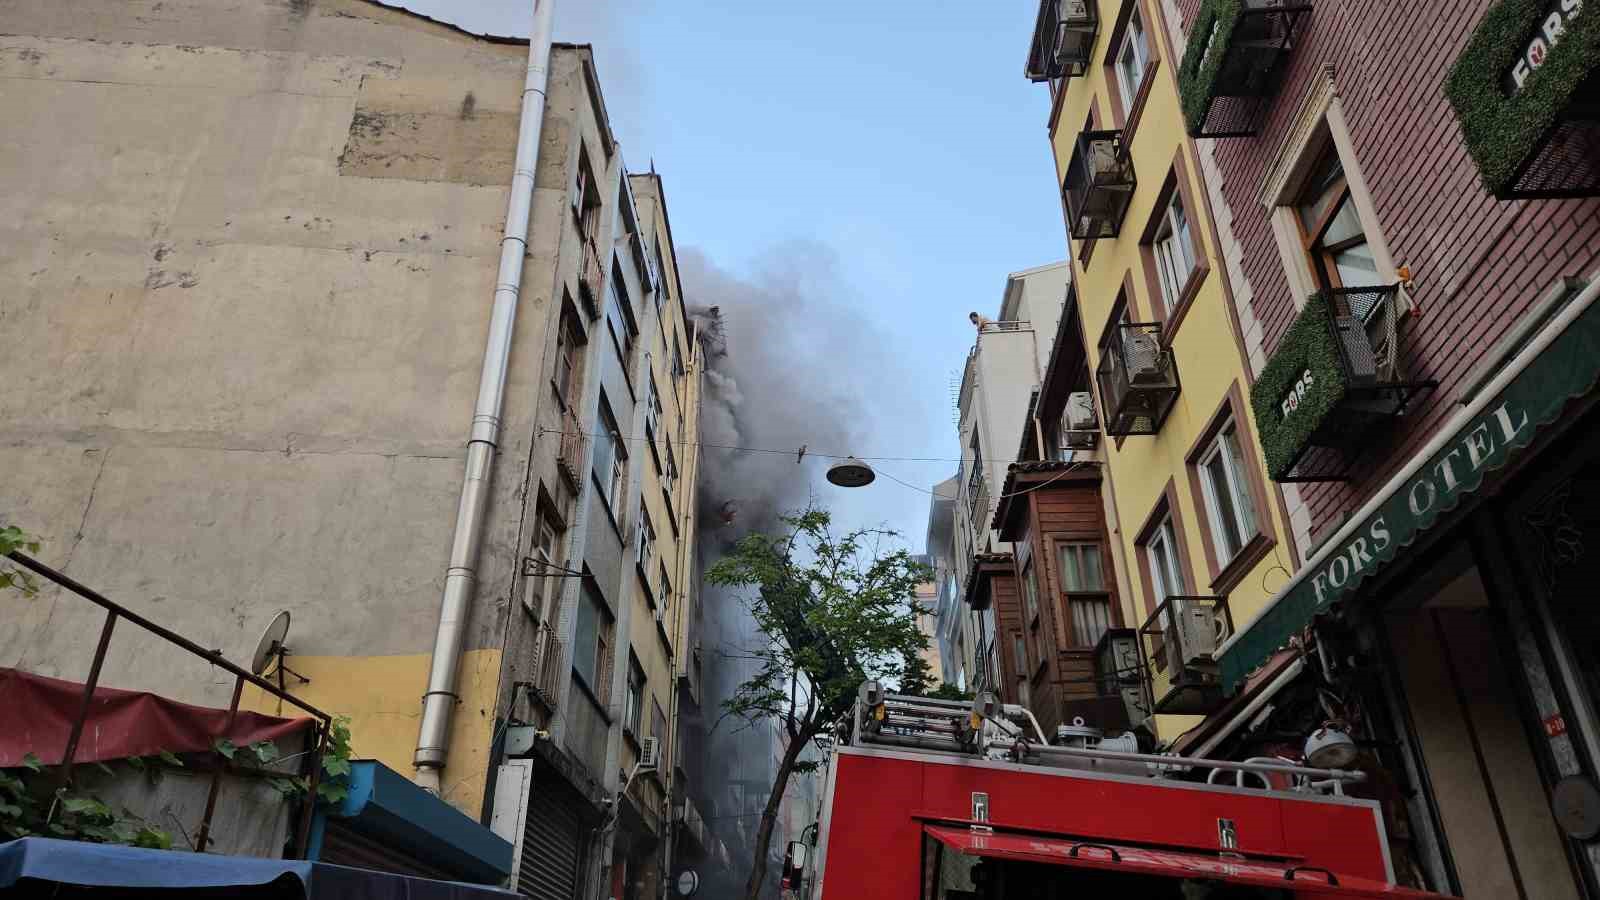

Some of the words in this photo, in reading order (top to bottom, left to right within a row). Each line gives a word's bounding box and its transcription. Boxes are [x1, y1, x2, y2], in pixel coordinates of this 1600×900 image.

[1281, 369, 1314, 417] FORS
[1311, 515, 1391, 604] FORS
[1408, 400, 1528, 515] OTEL
